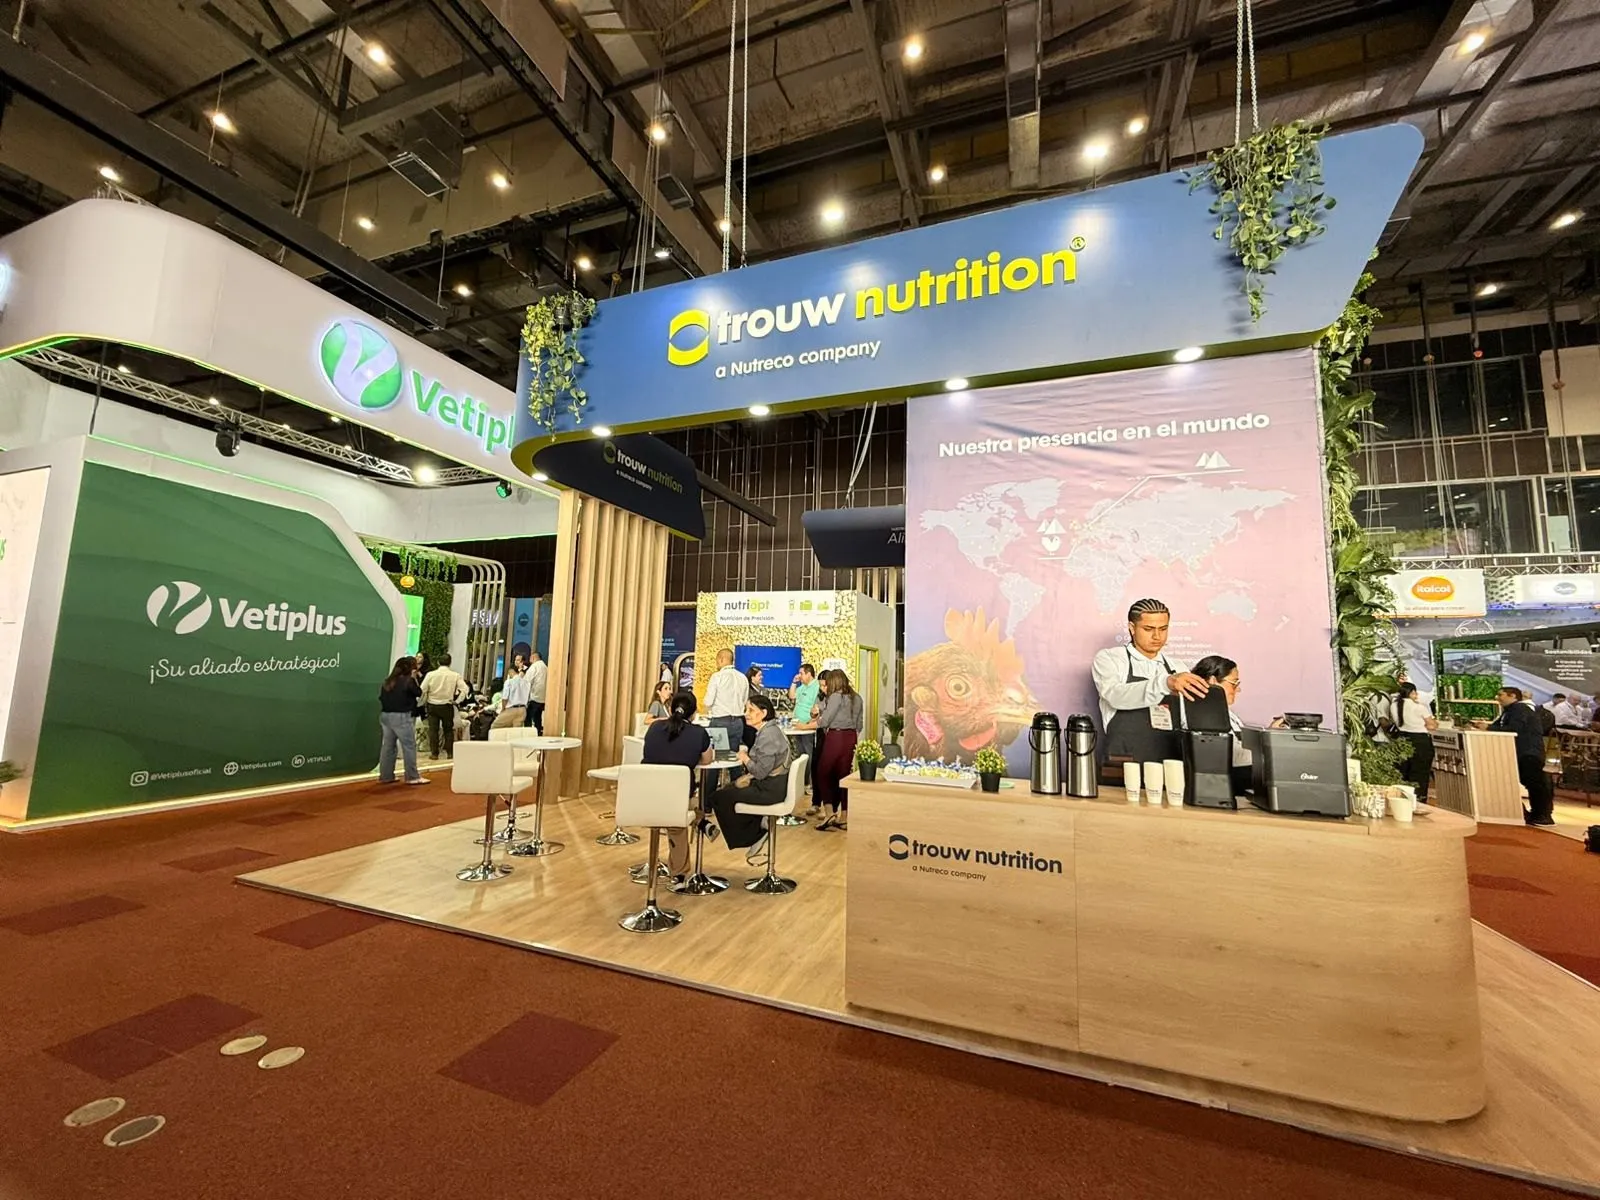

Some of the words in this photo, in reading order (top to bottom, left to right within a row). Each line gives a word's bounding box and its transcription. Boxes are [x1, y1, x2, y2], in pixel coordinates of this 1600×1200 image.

[715, 292, 847, 344] trouw
[715, 364, 726, 378] a
[731, 354, 794, 377] Nutreco
[798, 340, 882, 365] company
[938, 438, 1013, 458] Nuestra
[1017, 426, 1118, 453] presencia
[1122, 426, 1151, 440] en
[1156, 420, 1177, 437] el
[1183, 414, 1270, 435] mundo
[617, 449, 647, 475] trouw
[647, 468, 683, 494] nutrition
[724, 599, 770, 612] nutriopt
[1416, 584, 1451, 594] italcol
[218, 598, 347, 641] Vetiplus
[150, 658, 185, 684] ¡Su
[189, 656, 250, 676] aliado
[253, 652, 340, 674] estratégico!
[150, 767, 212, 781] @Vetiplusoficial
[307, 755, 332, 764] VETIPLUS
[912, 840, 971, 862] trouw
[975, 850, 1063, 874] nutrition
[919, 865, 949, 876] Nutreco
[950, 870, 987, 882] company
